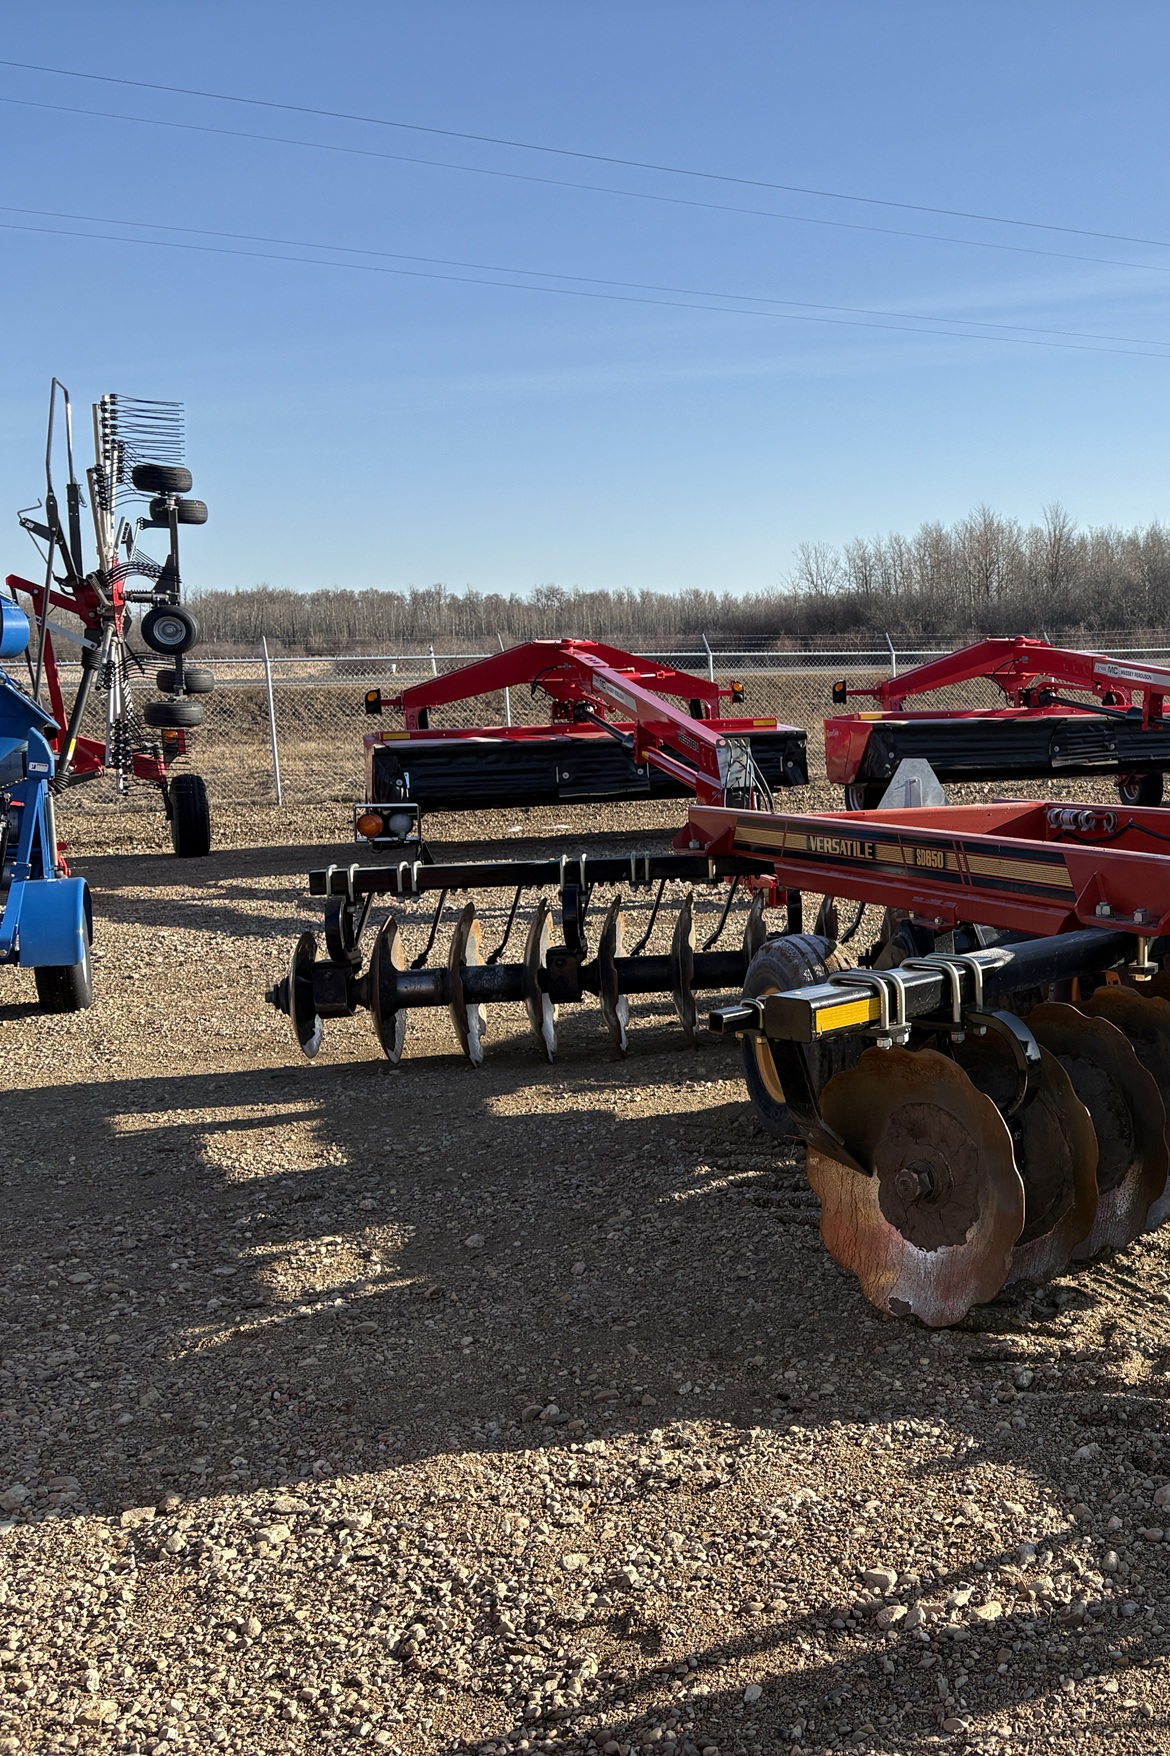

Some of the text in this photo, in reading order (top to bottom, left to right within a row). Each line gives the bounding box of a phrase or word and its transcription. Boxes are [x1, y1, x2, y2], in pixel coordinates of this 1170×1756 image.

[1107, 666, 1118, 675] MC
[1121, 669, 1134, 677] MASSEY
[1134, 672, 1152, 680] FERGUSON
[809, 836, 873, 859] VERSATILE
[916, 848, 944, 869] SD650
